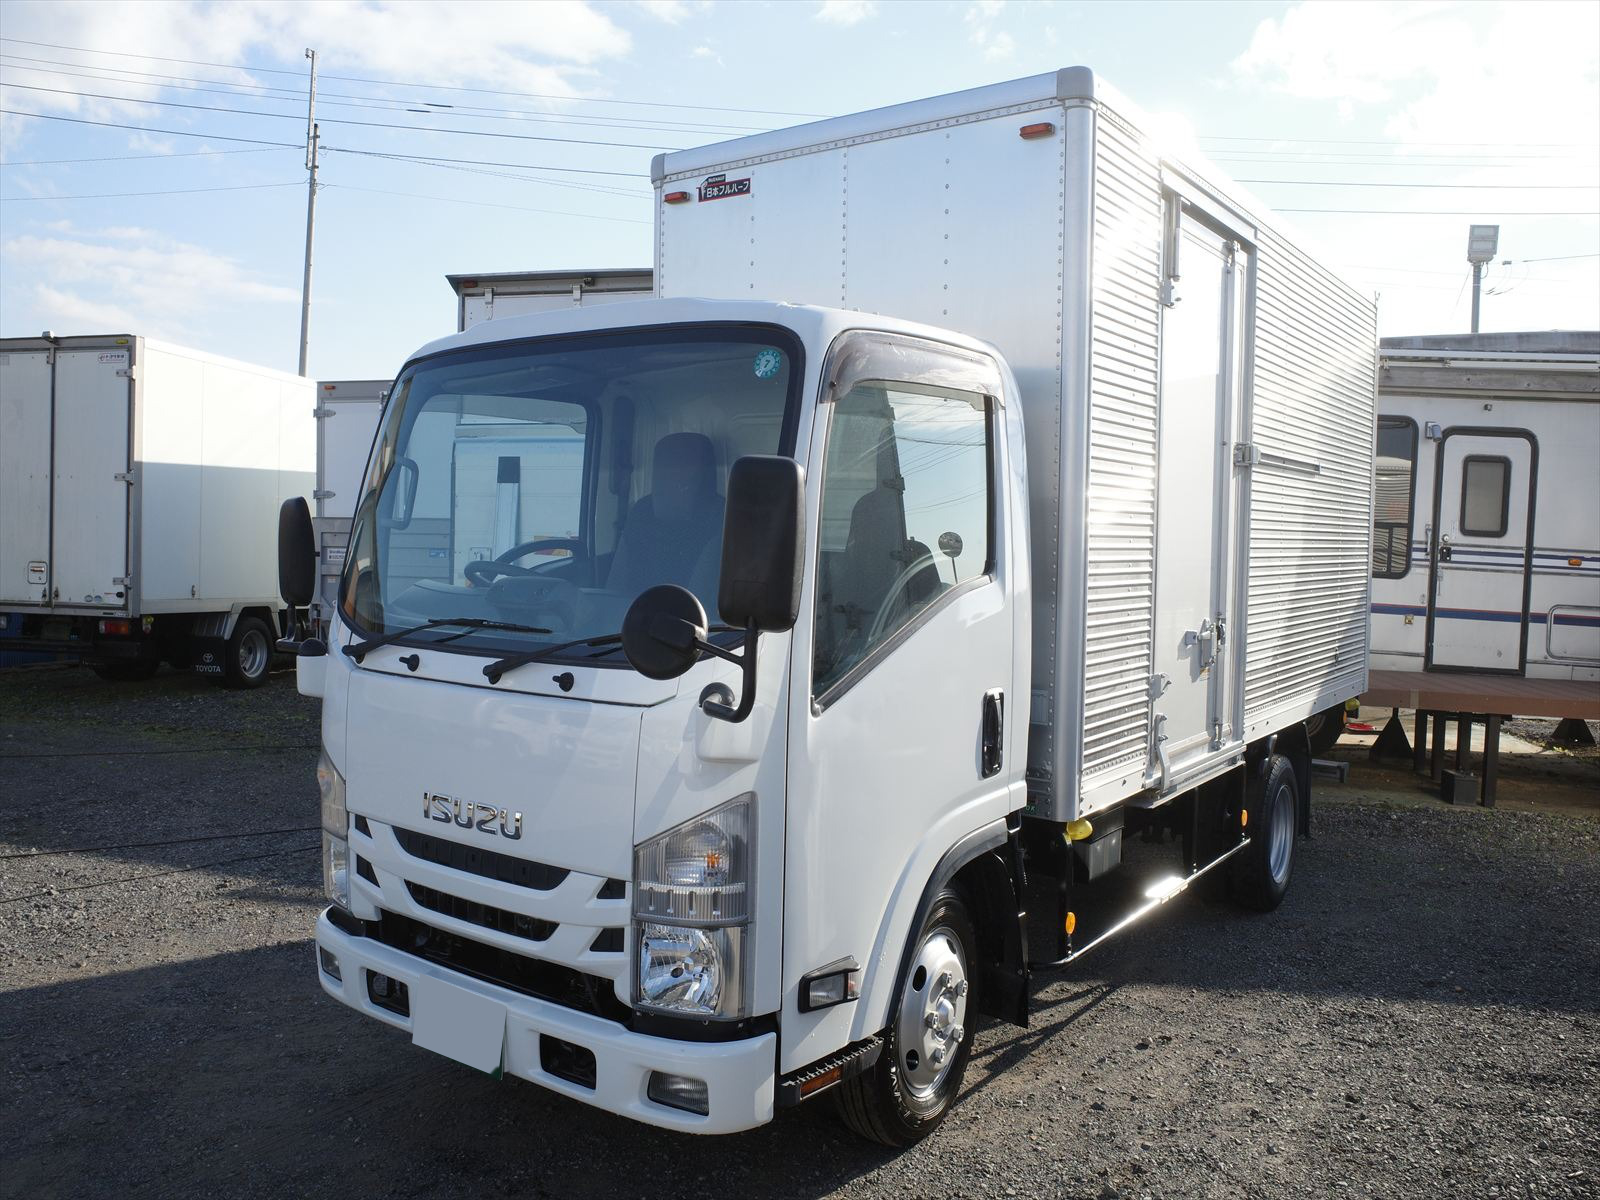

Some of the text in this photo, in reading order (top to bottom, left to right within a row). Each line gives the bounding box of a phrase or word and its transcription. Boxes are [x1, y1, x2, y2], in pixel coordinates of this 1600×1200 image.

[706, 181, 749, 198] 日本フルハーフ
[423, 792, 523, 840] ISUZU
